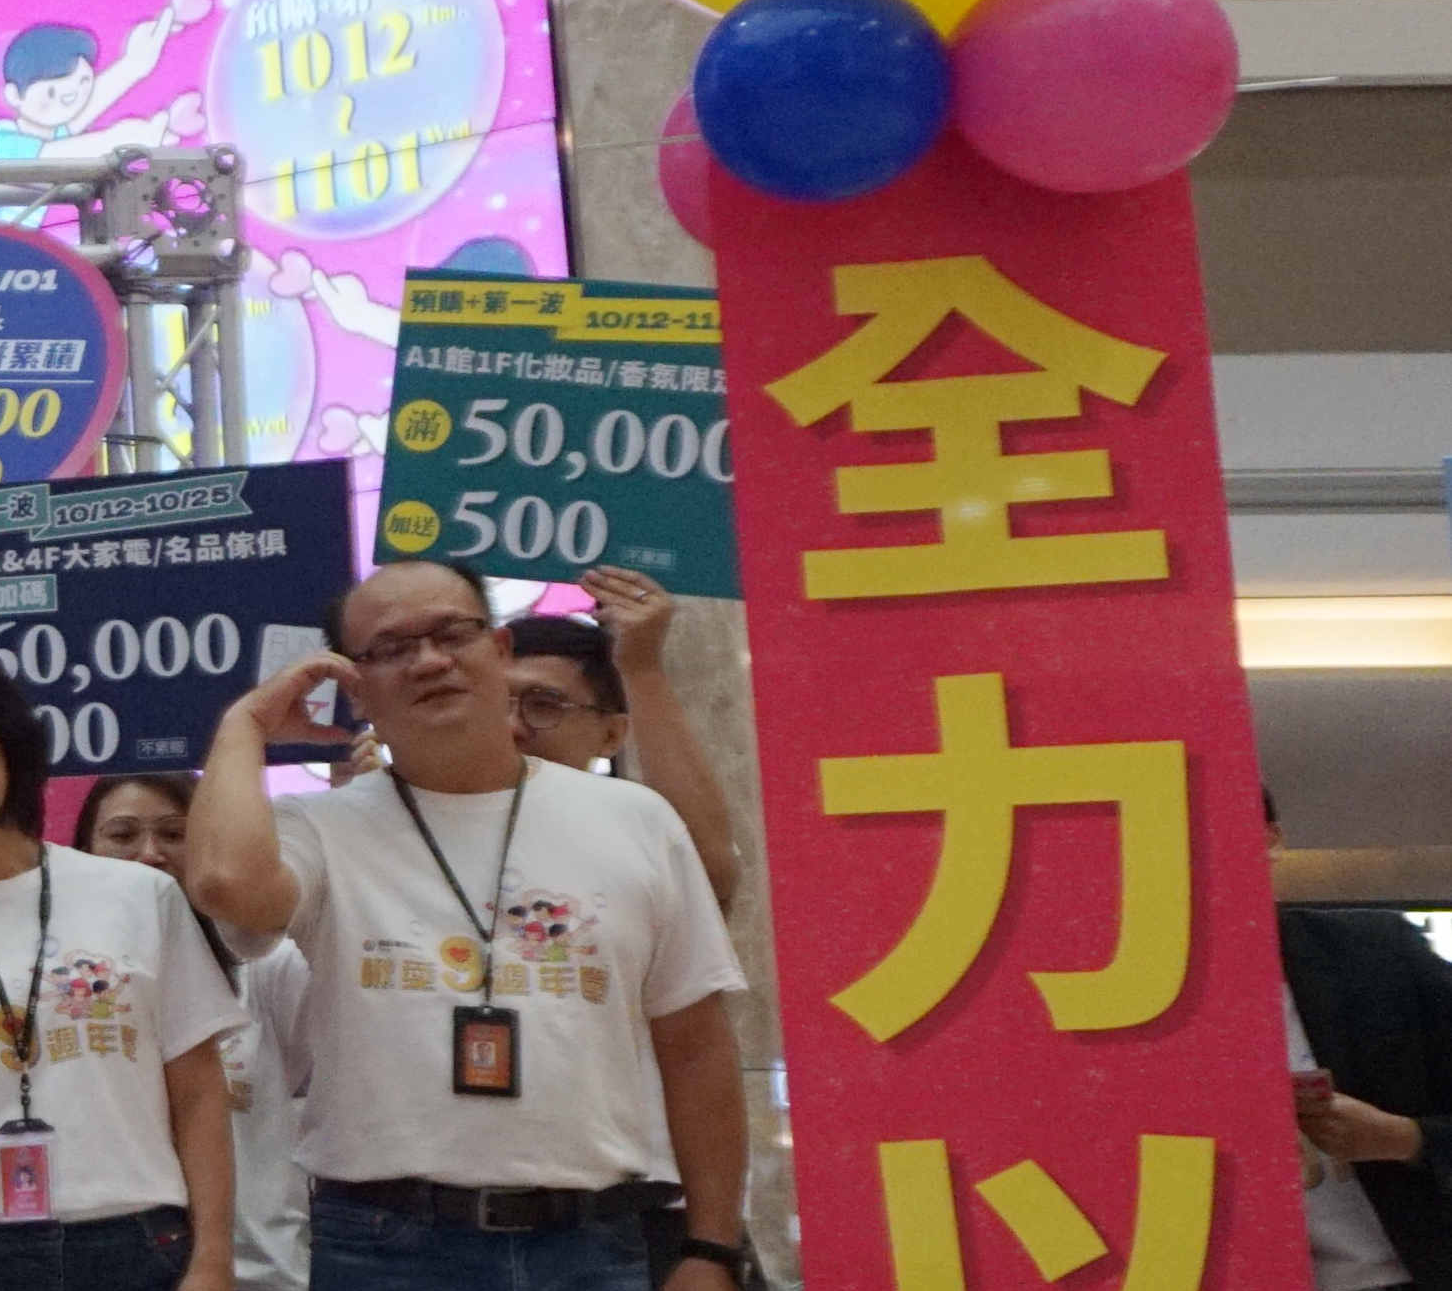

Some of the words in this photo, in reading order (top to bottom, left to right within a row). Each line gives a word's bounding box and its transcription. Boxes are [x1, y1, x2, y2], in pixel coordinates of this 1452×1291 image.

[587, 311, 718, 330] 10/12-11
[56, 485, 230, 526] 10/12-10/25
[448, 490, 608, 564] 500
